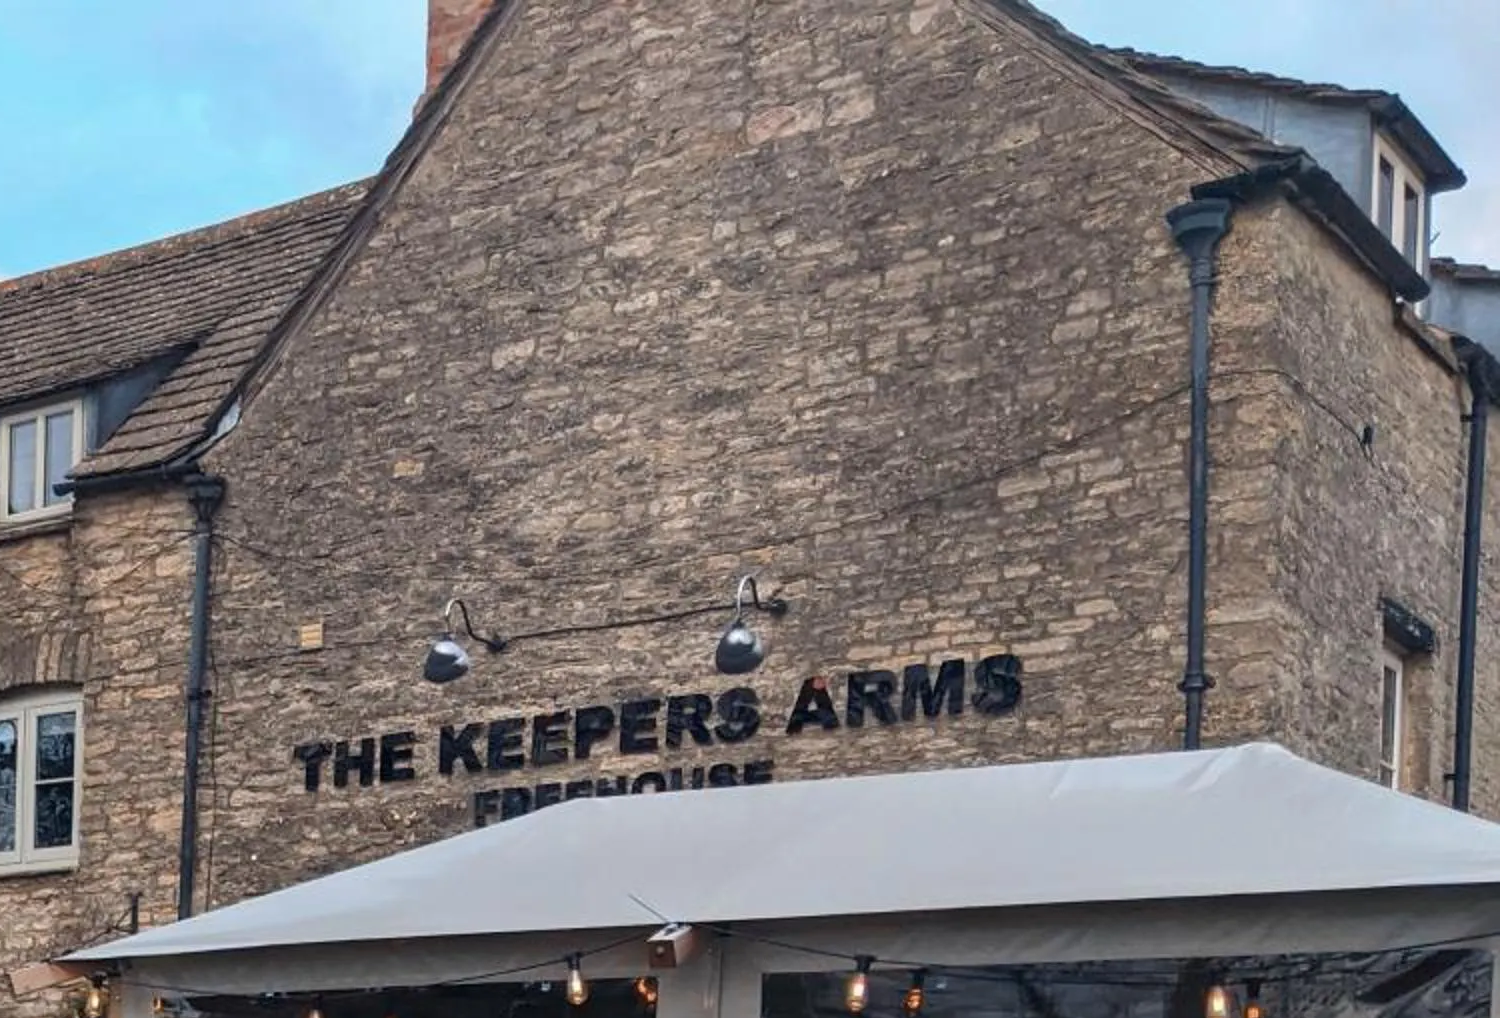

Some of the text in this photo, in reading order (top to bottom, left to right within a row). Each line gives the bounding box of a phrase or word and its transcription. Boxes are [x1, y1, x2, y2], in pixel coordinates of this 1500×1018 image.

[294, 653, 1022, 792] THE KEEPERS ARMS
